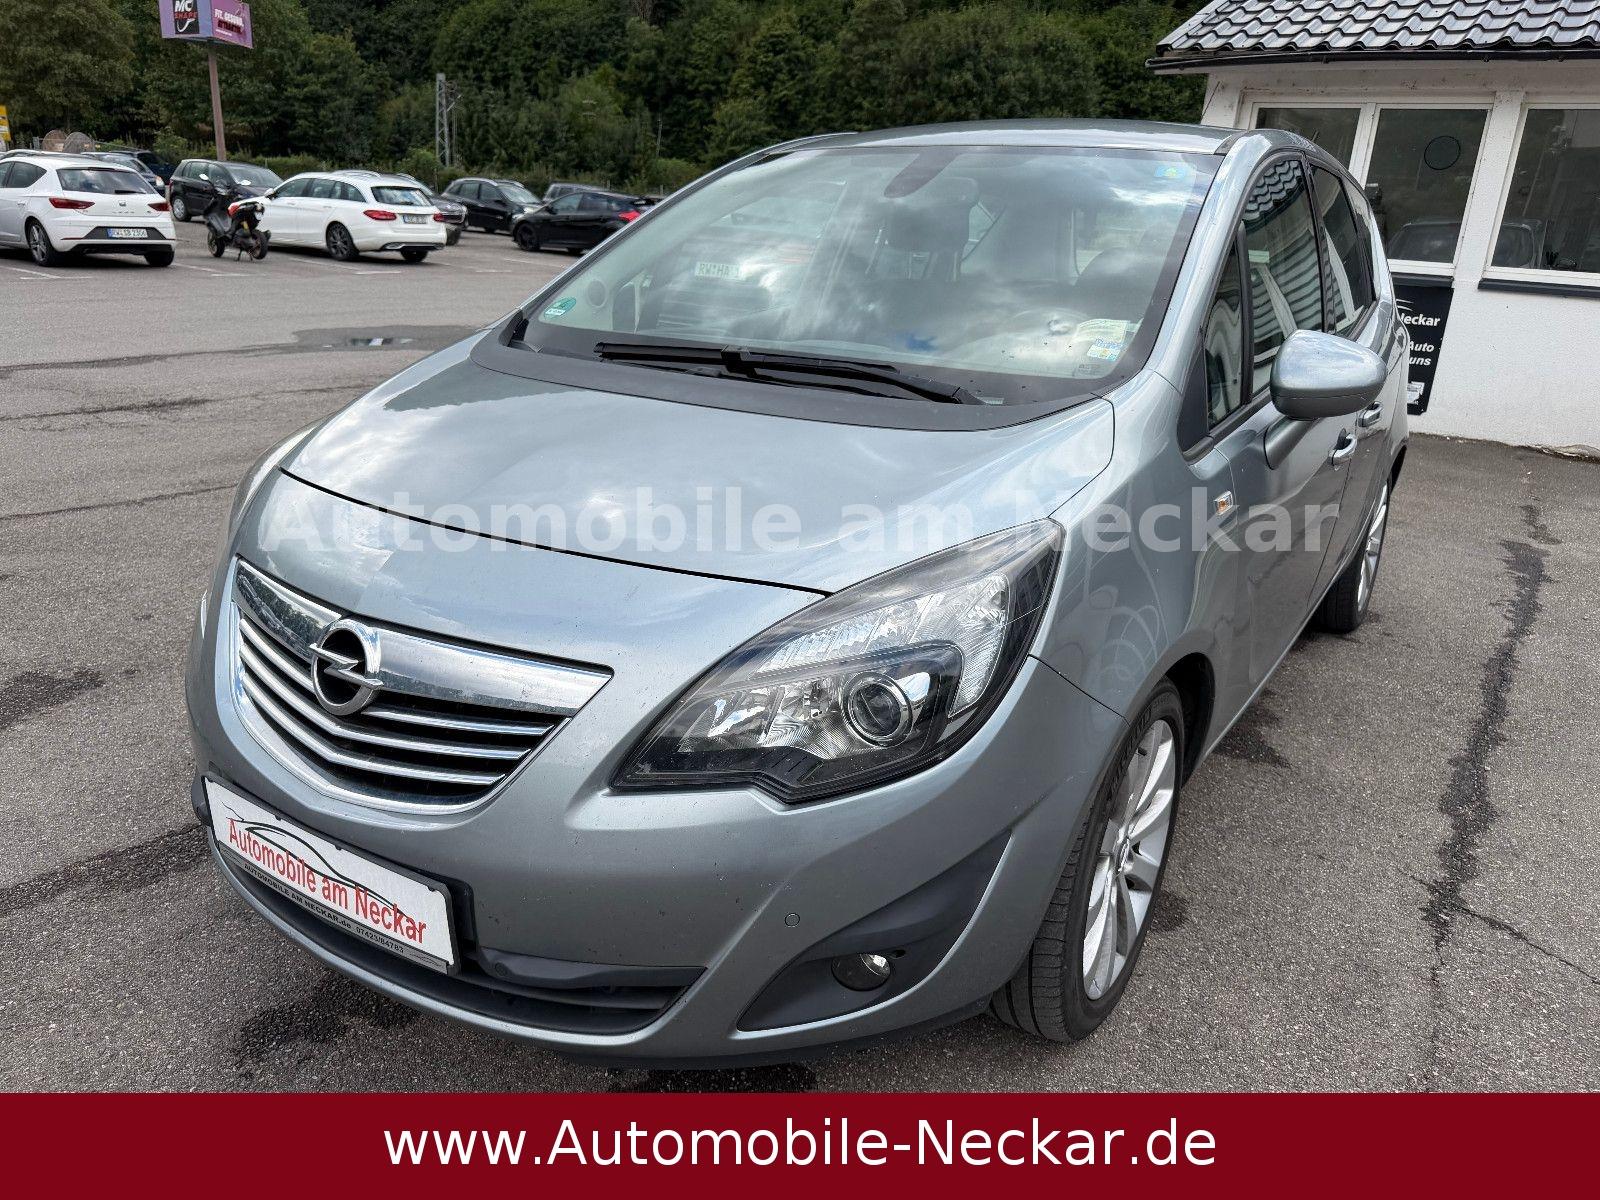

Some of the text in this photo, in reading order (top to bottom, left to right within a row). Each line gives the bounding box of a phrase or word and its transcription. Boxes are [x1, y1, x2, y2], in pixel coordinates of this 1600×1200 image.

[174, 0, 194, 12] MC
[228, 818, 427, 944] Automobile am Neckar
